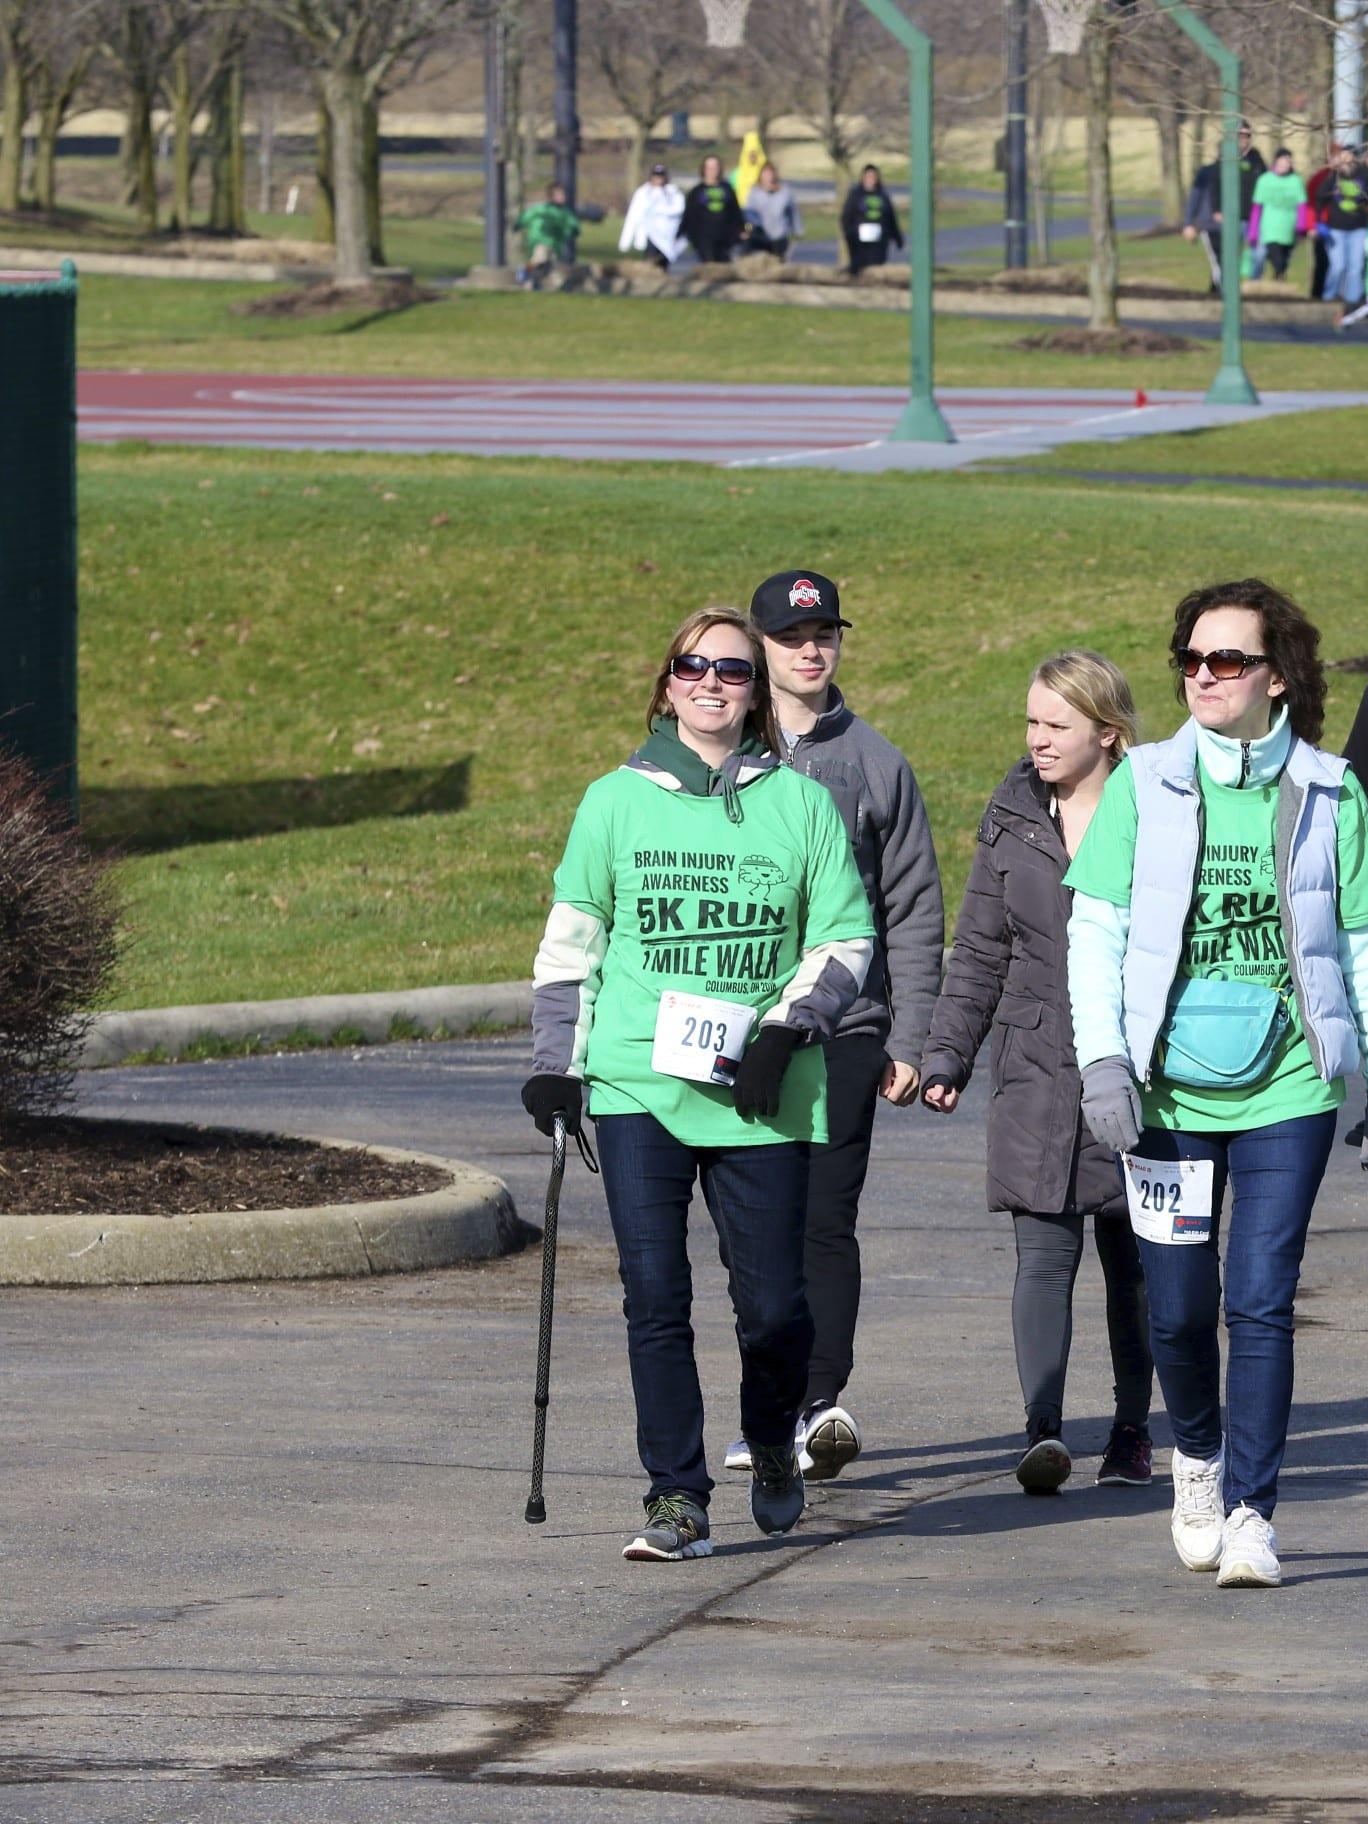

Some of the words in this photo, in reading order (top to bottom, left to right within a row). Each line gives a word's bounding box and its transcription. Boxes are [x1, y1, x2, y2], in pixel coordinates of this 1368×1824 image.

[634, 849, 677, 869] BRAIN
[681, 851, 736, 871] INJURY
[1207, 845, 1259, 863] INJURY
[641, 873, 729, 894] AWARENESS
[1199, 867, 1252, 886] RENESS
[636, 897, 685, 934] 5K
[698, 899, 786, 930] RUN
[1221, 892, 1280, 920] RU
[650, 945, 710, 976] MILE
[716, 939, 783, 980] WALK
[1234, 963, 1277, 977] COLUMBUS,
[705, 980, 749, 994] COLUMBUS,
[681, 1016, 728, 1053] 203
[1140, 1179, 1181, 1214] 202
